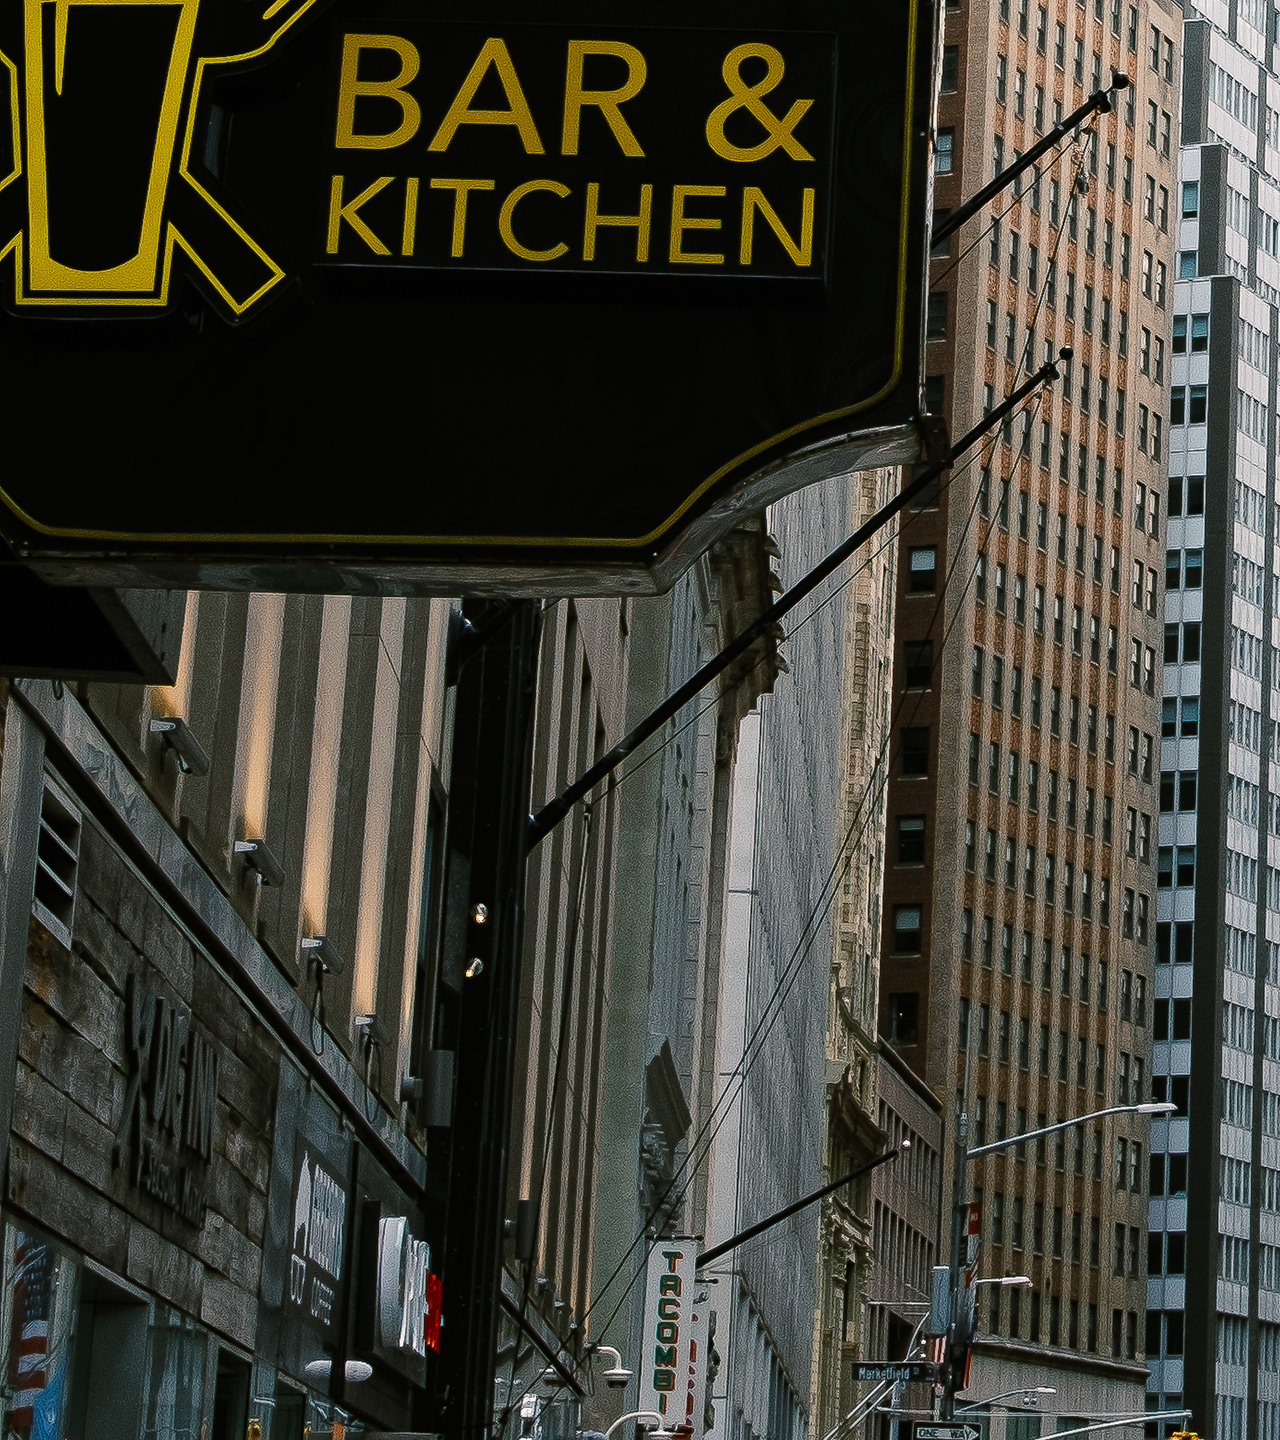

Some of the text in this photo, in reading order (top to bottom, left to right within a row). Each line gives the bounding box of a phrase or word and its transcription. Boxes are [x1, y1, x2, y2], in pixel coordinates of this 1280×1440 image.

[335, 33, 816, 163] BAR &
[326, 175, 815, 266] KITCHEN
[653, 1251, 683, 1414] TACOMBI
